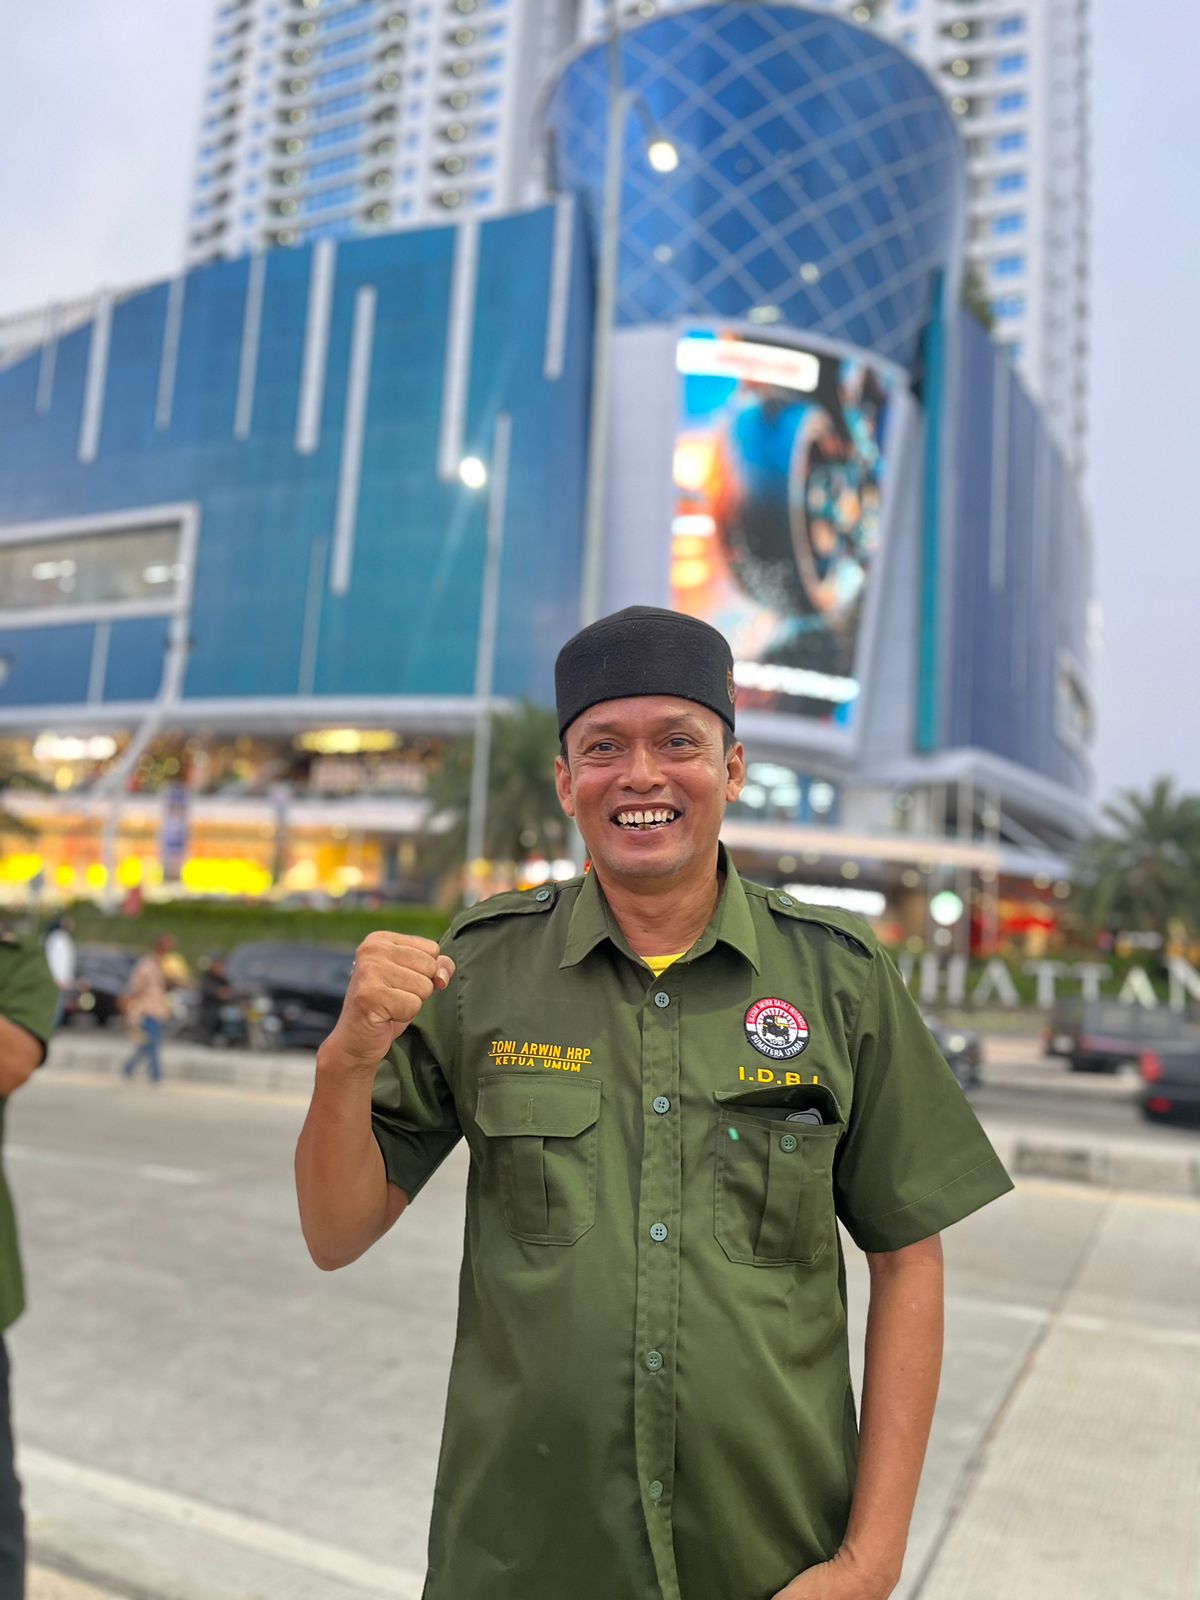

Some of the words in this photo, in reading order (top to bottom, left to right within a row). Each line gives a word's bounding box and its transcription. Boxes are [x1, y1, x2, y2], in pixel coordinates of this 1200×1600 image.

[898, 951, 1200, 1012] HATTAN
[491, 1040, 516, 1054] TONI
[521, 1042, 562, 1058] ARWIN
[566, 1046, 592, 1061] HRP
[751, 1034, 783, 1057] SUMATERA
[785, 1040, 804, 1056] UTARA
[495, 1056, 535, 1067] KETUA
[543, 1059, 581, 1072] UMUM
